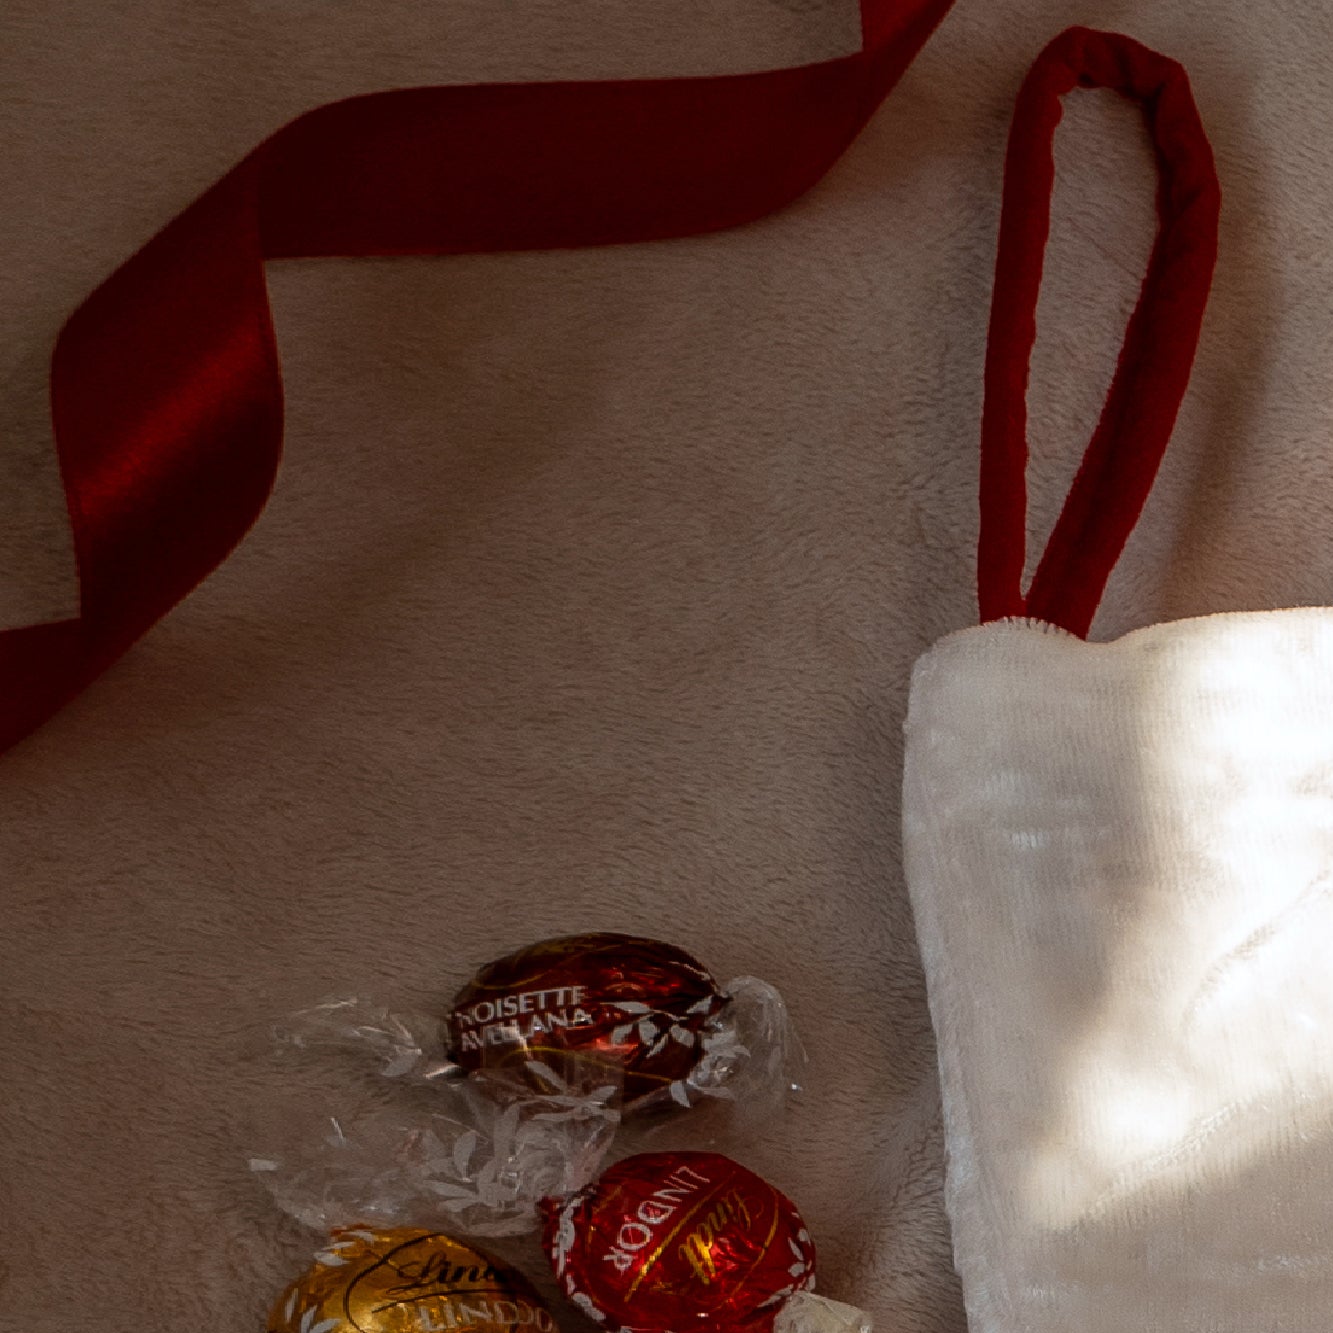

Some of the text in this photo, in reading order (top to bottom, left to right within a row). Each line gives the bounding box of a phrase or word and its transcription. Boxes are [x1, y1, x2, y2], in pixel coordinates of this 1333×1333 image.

[455, 985, 588, 1029] NOISETTE
[461, 1008, 593, 1052] AVELLANA
[603, 1166, 711, 1277] LINDOR
